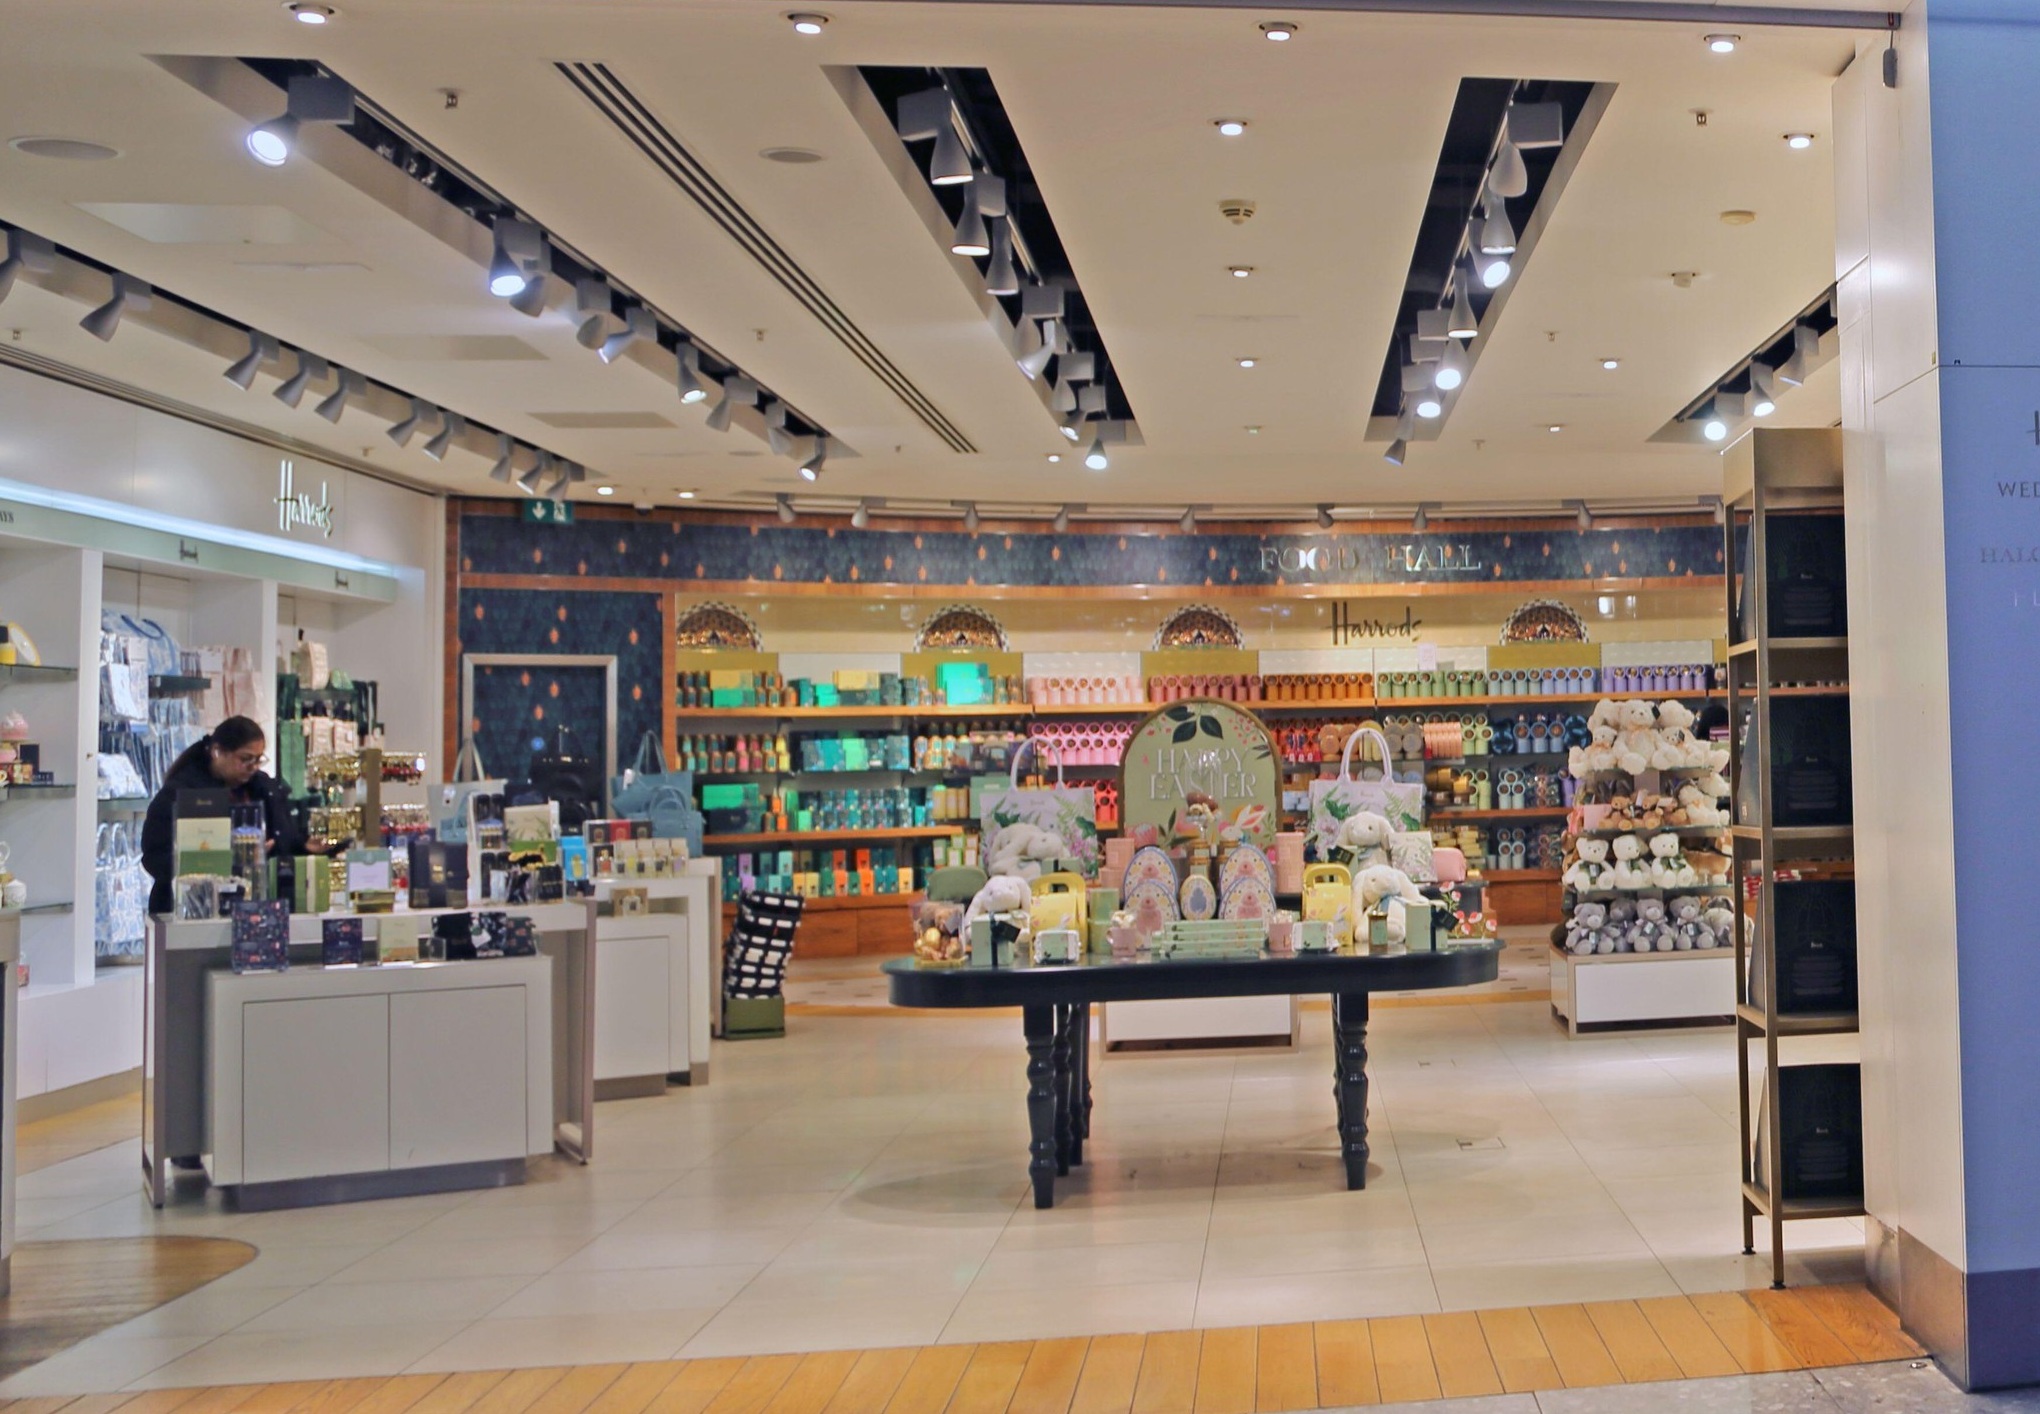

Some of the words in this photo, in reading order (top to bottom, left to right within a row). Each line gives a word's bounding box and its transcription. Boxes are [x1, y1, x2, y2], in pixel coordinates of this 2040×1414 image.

[273, 459, 333, 539] Harrods
[1260, 546, 1359, 573] FOOD
[1384, 544, 1482, 572] HALL
[1326, 601, 1422, 645] Harrods
